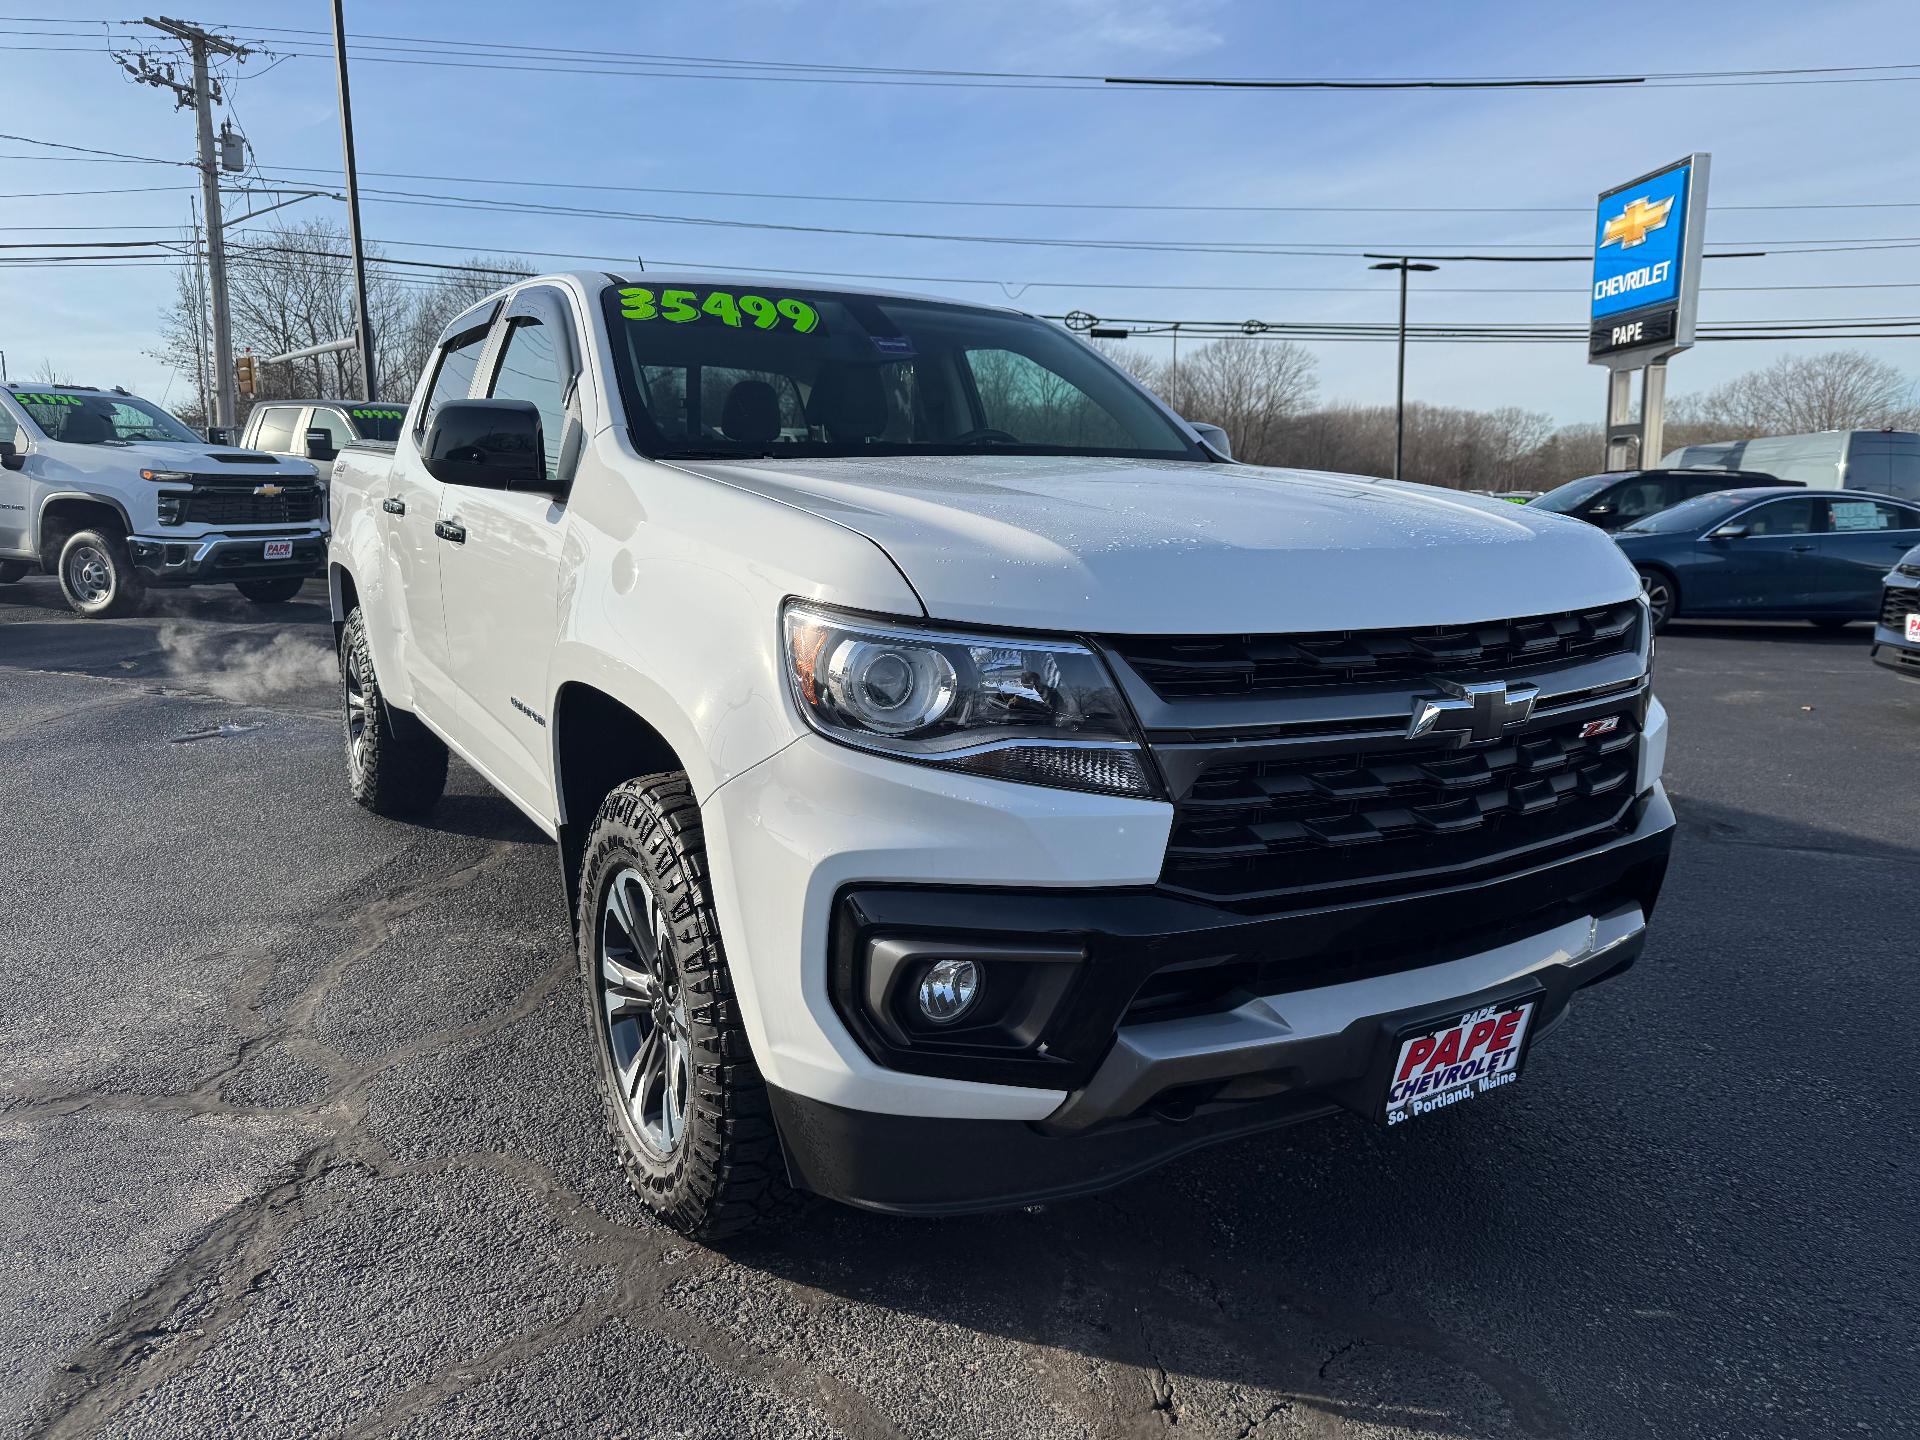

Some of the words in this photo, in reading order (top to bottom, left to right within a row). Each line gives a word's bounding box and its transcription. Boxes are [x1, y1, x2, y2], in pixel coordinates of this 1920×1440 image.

[1594, 260, 1671, 300] CHEVROLET
[618, 286, 820, 335] 35499
[1611, 321, 1643, 346] PAPE
[267, 543, 290, 553] PAPE
[1459, 1004, 1497, 1026] PAPE
[1397, 1009, 1525, 1083] PAPE
[1388, 1046, 1518, 1104] CHEVROLET
[1387, 1110, 1409, 1126] So.
[1413, 1083, 1475, 1116] Portland,
[1477, 1071, 1518, 1093] Maine
